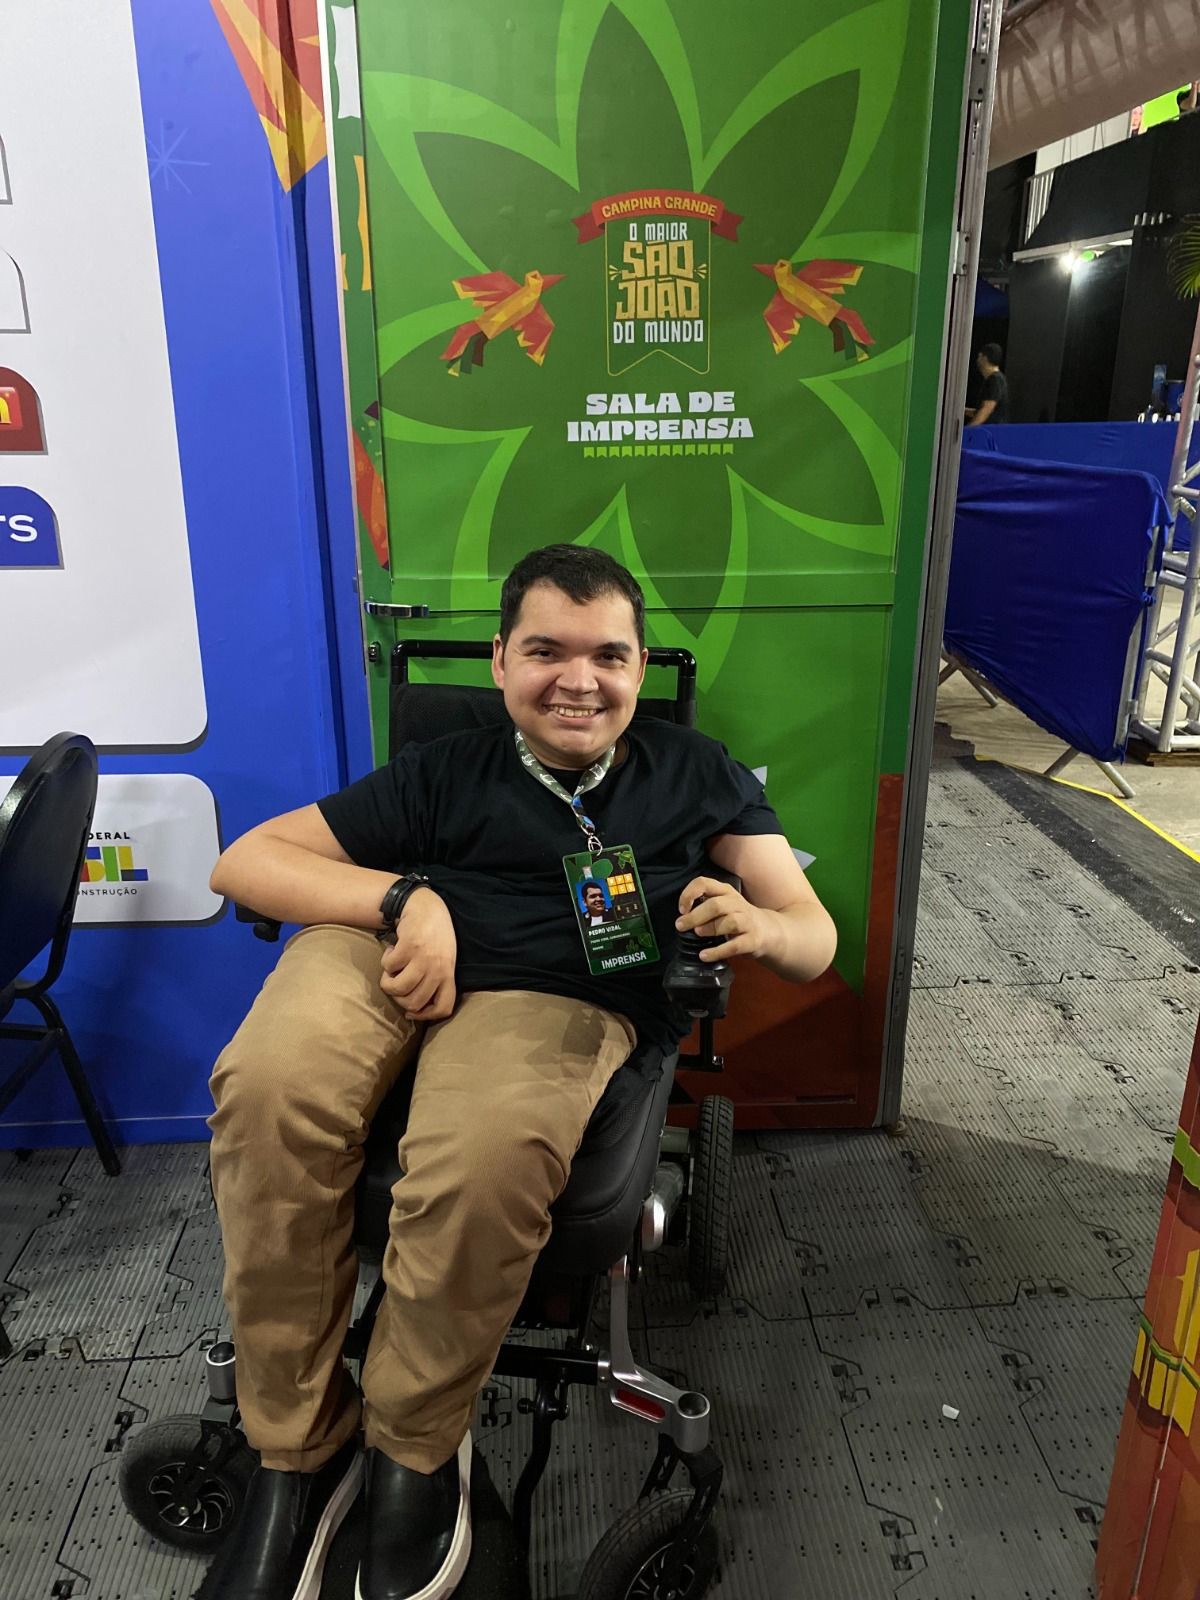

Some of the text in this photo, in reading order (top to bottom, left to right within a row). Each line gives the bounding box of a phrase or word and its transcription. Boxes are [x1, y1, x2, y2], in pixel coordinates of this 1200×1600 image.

[602, 196, 717, 218] CAMPINA GRANDE
[629, 222, 688, 242] O MAIOR
[621, 240, 694, 280] SÃO
[615, 277, 700, 320] JOÃO
[613, 320, 704, 344] DO MUNDO
[586, 391, 735, 415] SALA DE
[567, 418, 754, 442] IMPRENSA
[78, 887, 138, 896] NSTRUÇÃO
[601, 951, 647, 970] IMPRENSA
